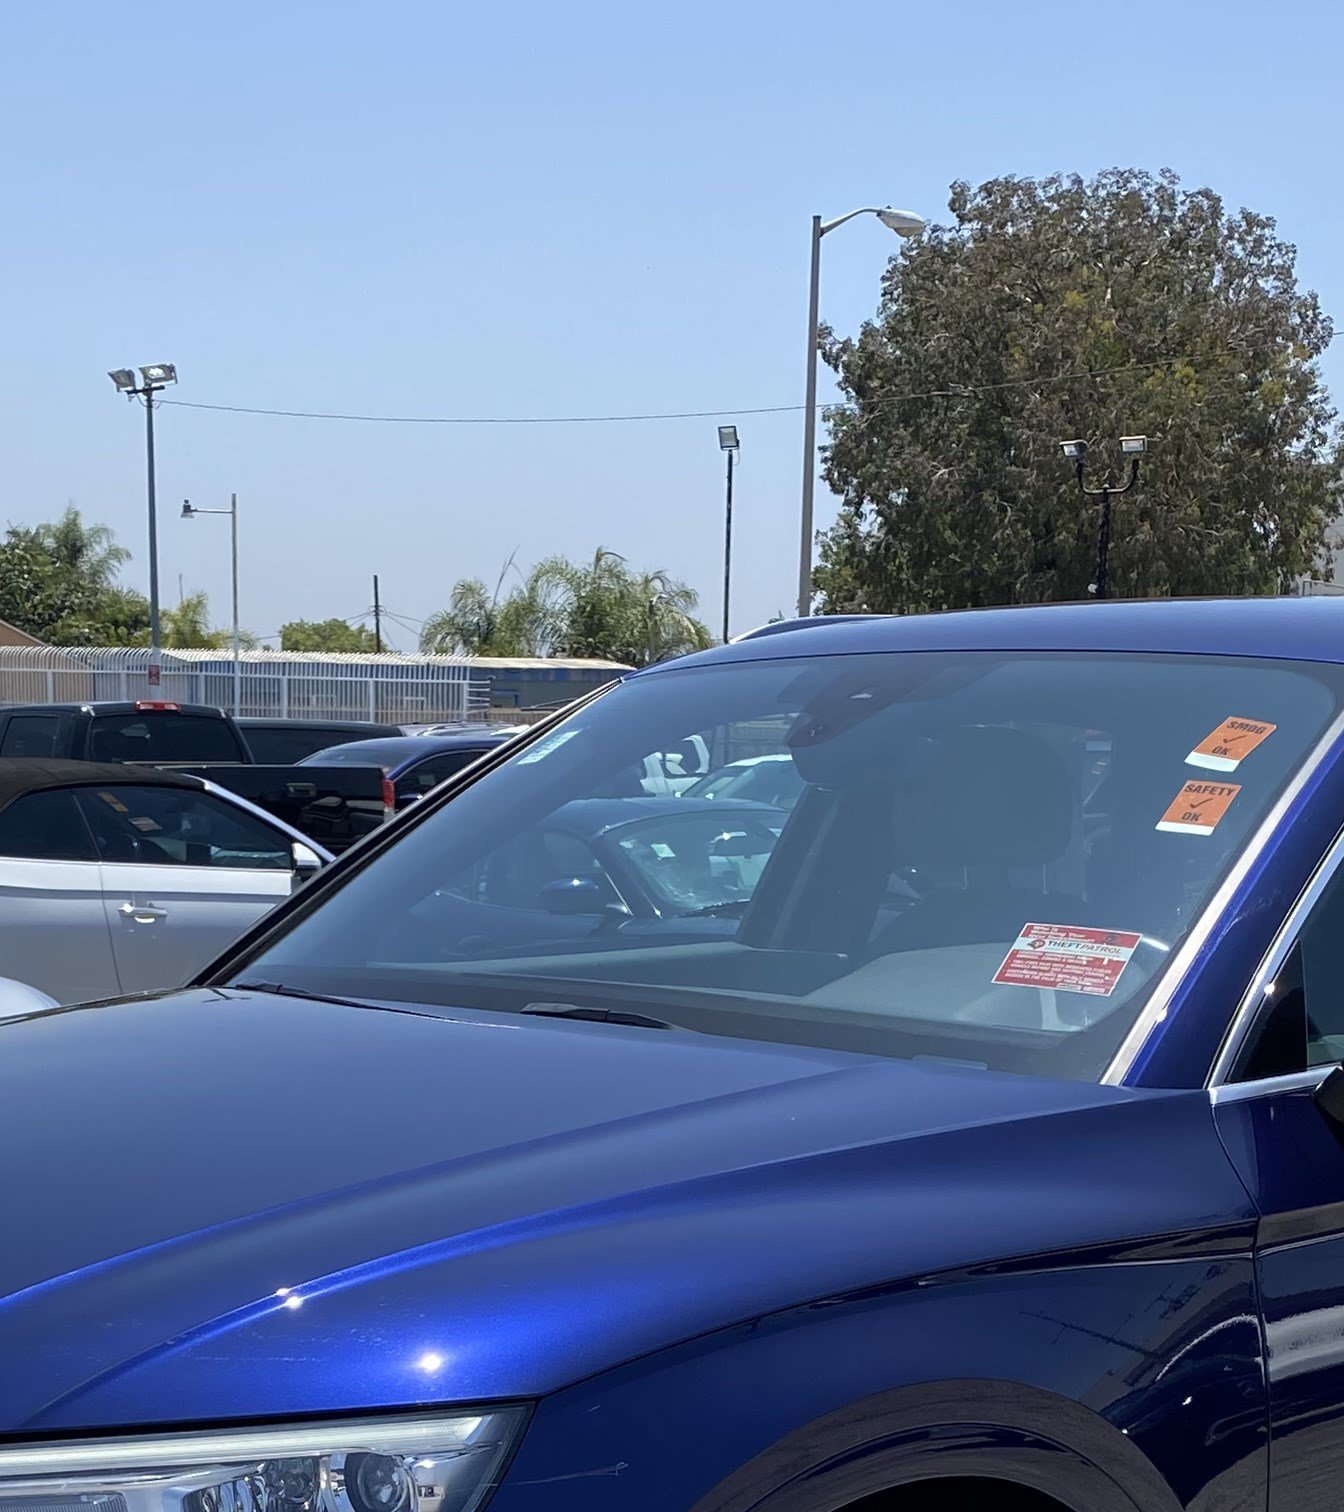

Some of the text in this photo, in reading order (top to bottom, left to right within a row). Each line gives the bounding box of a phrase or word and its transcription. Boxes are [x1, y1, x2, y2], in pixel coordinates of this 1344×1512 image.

[1226, 721, 1267, 735] SMOG
[1211, 746, 1232, 756] OK
[1184, 783, 1236, 797] SAFETY
[1181, 812, 1202, 822] OK
